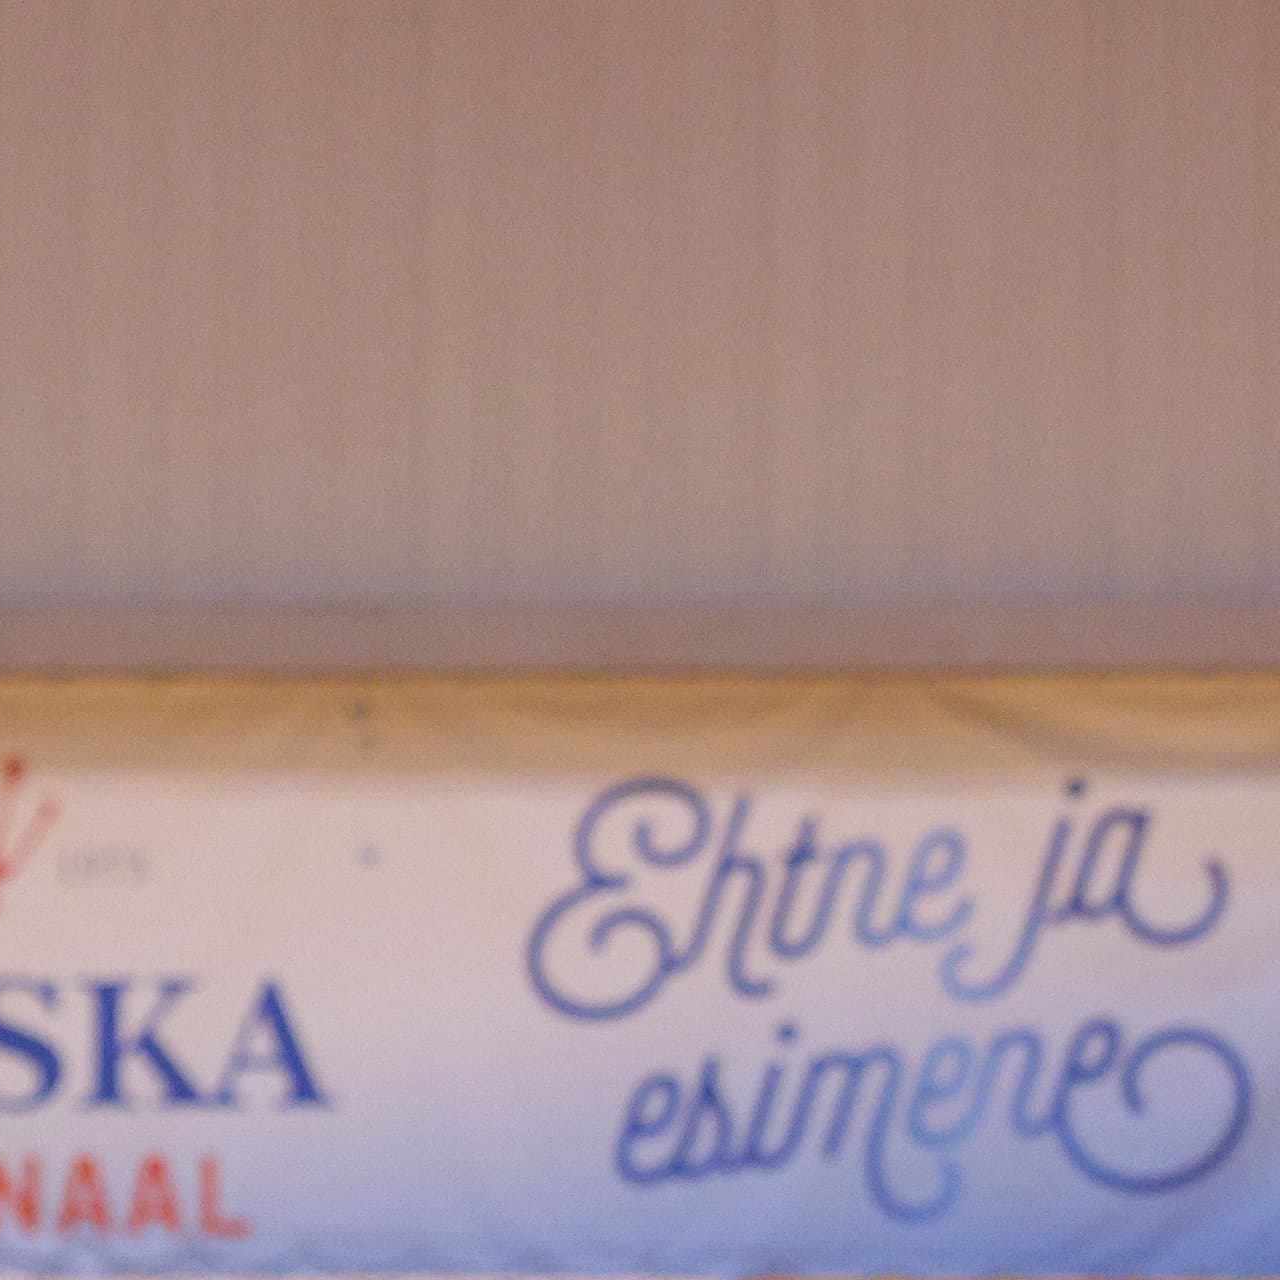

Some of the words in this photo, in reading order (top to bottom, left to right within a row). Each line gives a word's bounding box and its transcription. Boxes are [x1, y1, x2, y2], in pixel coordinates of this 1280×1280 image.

[525, 774, 977, 1024] Ehtne
[938, 774, 1230, 1005] ja
[614, 1017, 1256, 1226] esimene
